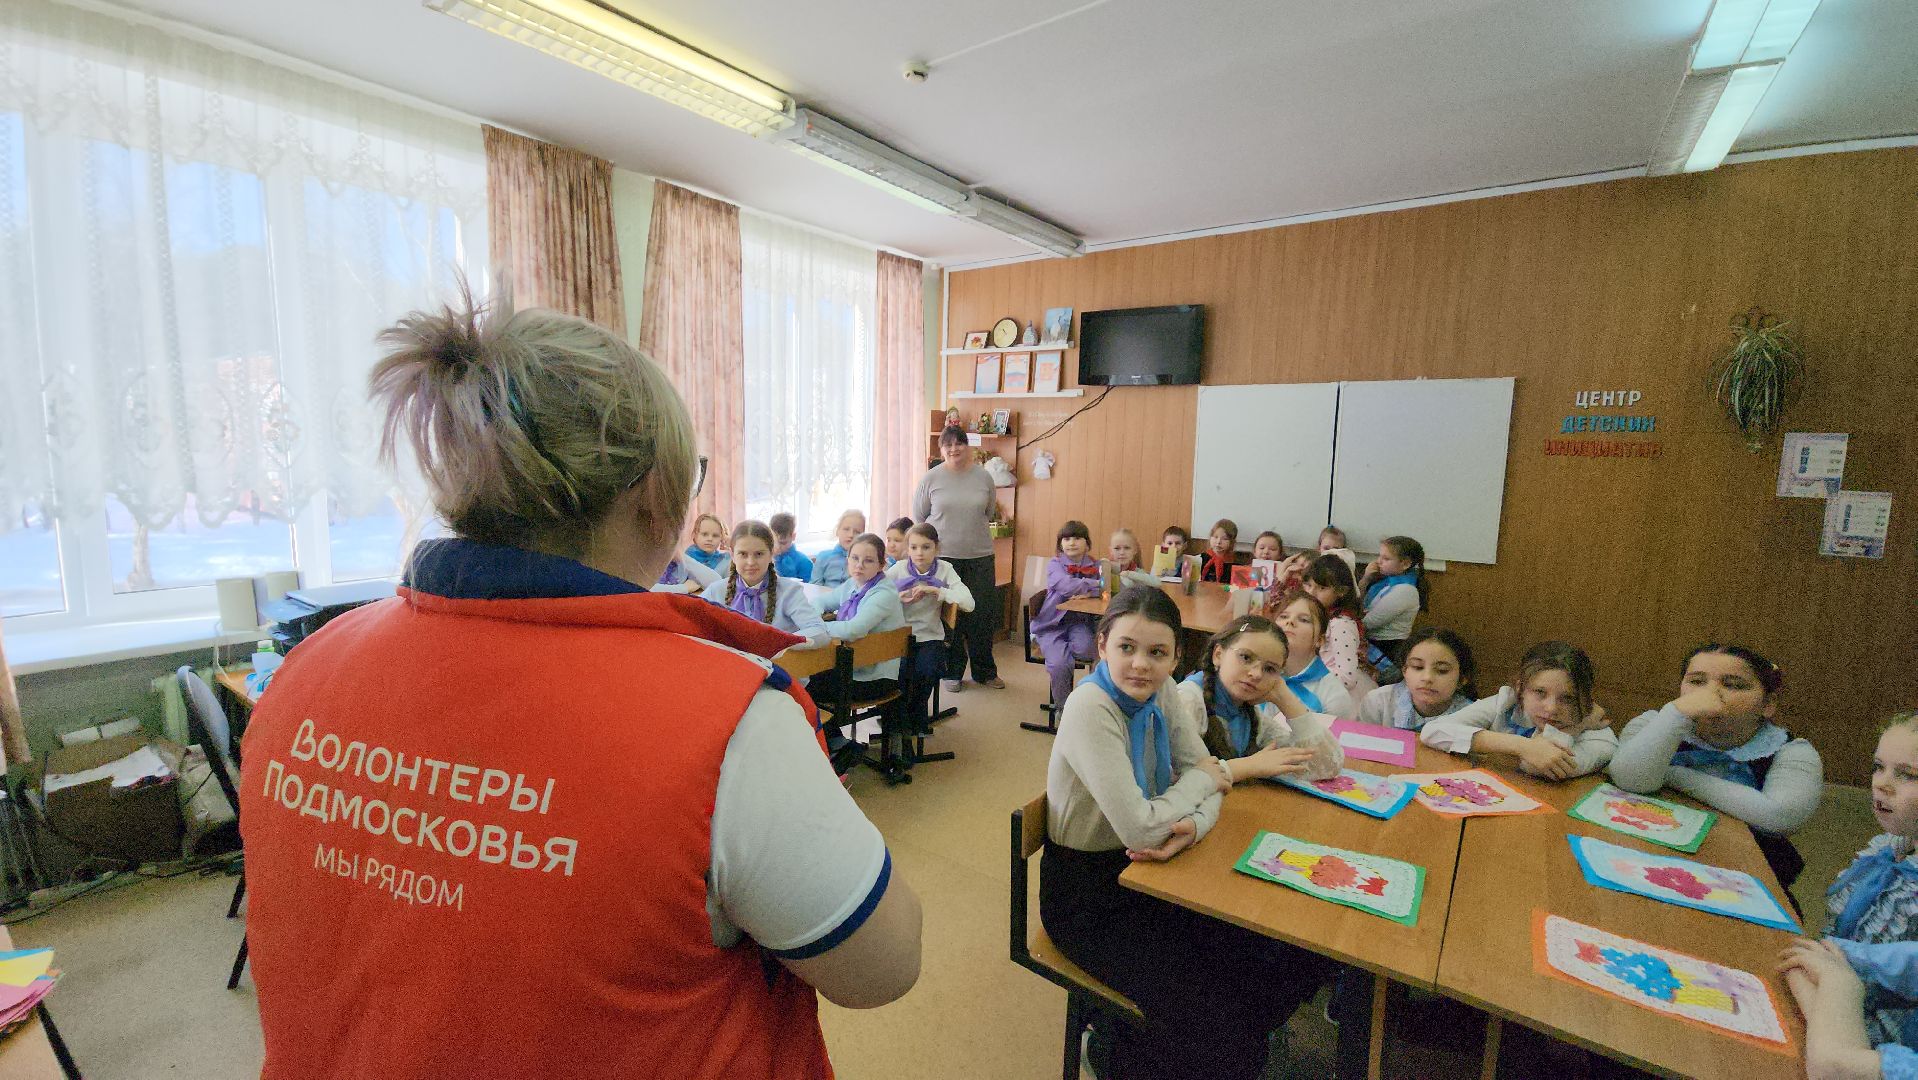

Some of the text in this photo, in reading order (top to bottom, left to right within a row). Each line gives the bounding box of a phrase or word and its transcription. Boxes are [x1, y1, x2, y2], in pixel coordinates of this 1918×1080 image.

[1575, 390, 1641, 409] ЦЕНТР
[290, 718, 556, 815] ВОЛОНТЕРЫ
[263, 760, 579, 877] ПОДМОСКОВЬЯ
[314, 843, 465, 912] МЫ РЯДОМ
